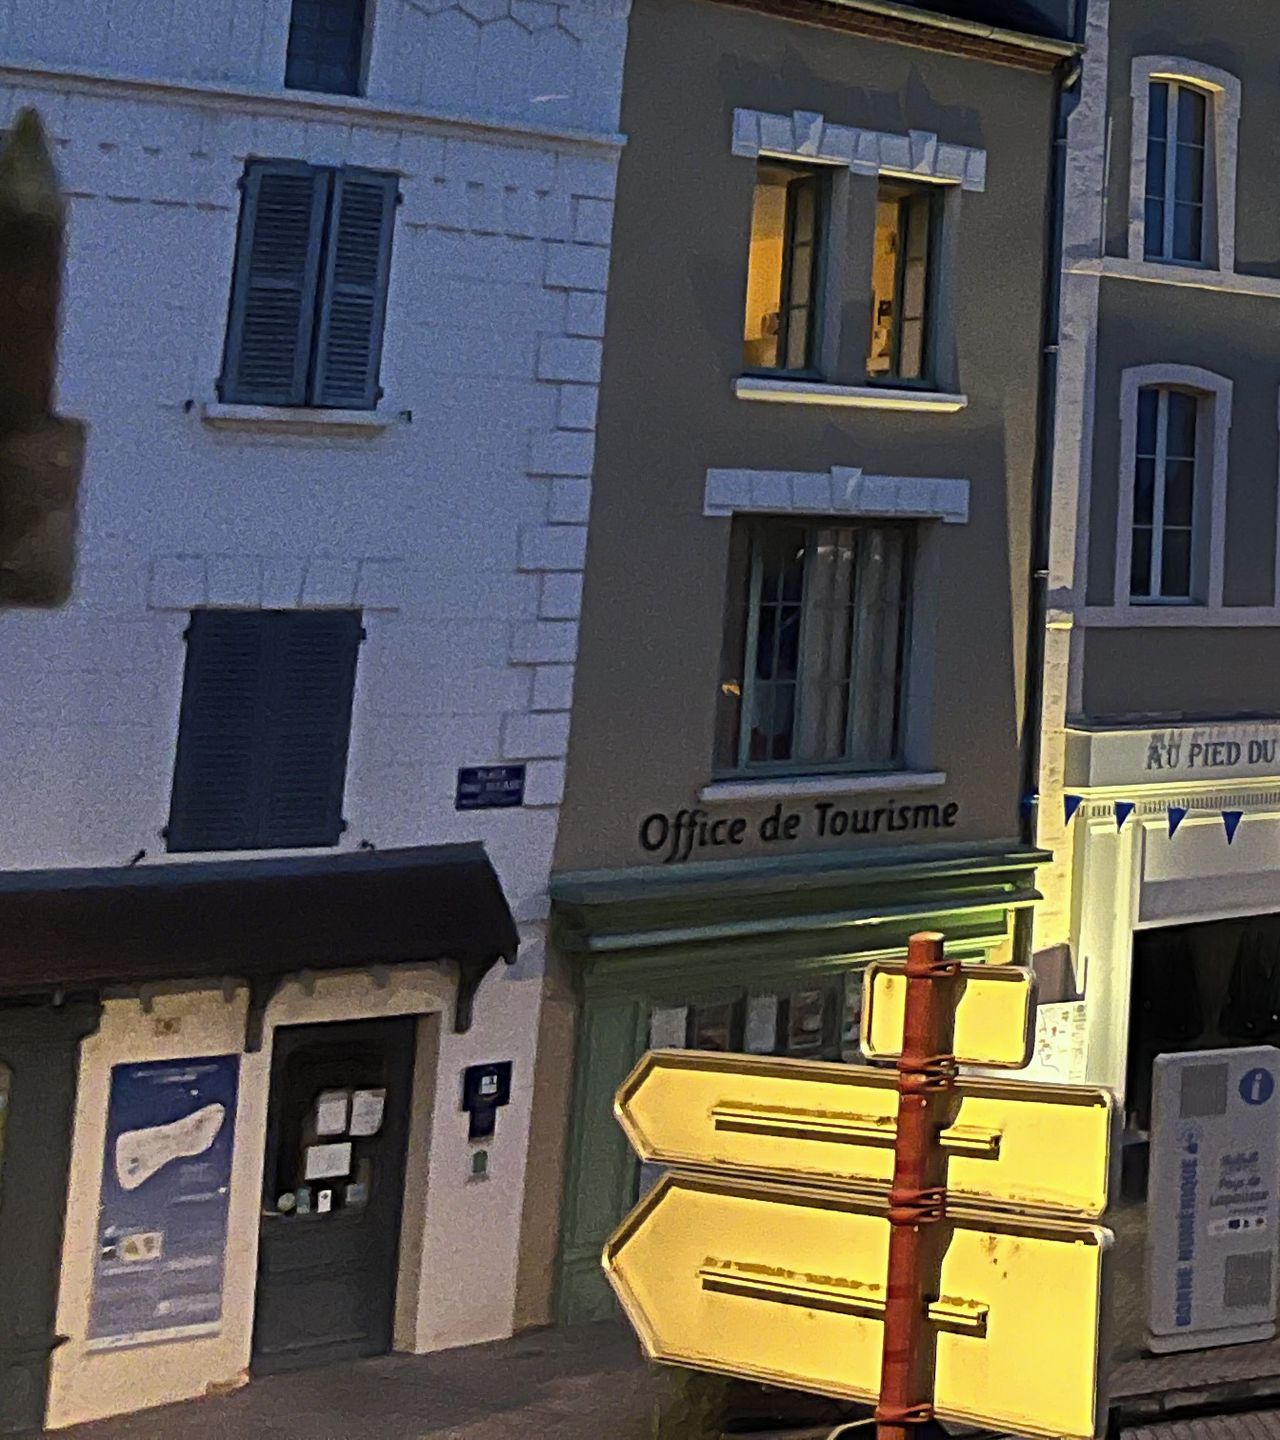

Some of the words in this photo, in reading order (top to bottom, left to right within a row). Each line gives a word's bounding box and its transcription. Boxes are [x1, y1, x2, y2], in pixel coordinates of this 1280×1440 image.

[1145, 743, 1181, 770] AU
[1187, 741, 1241, 768] PIED
[1247, 739, 1278, 765] DU
[638, 809, 747, 864] Office
[759, 804, 800, 842] de
[814, 799, 960, 837] Tourisme
